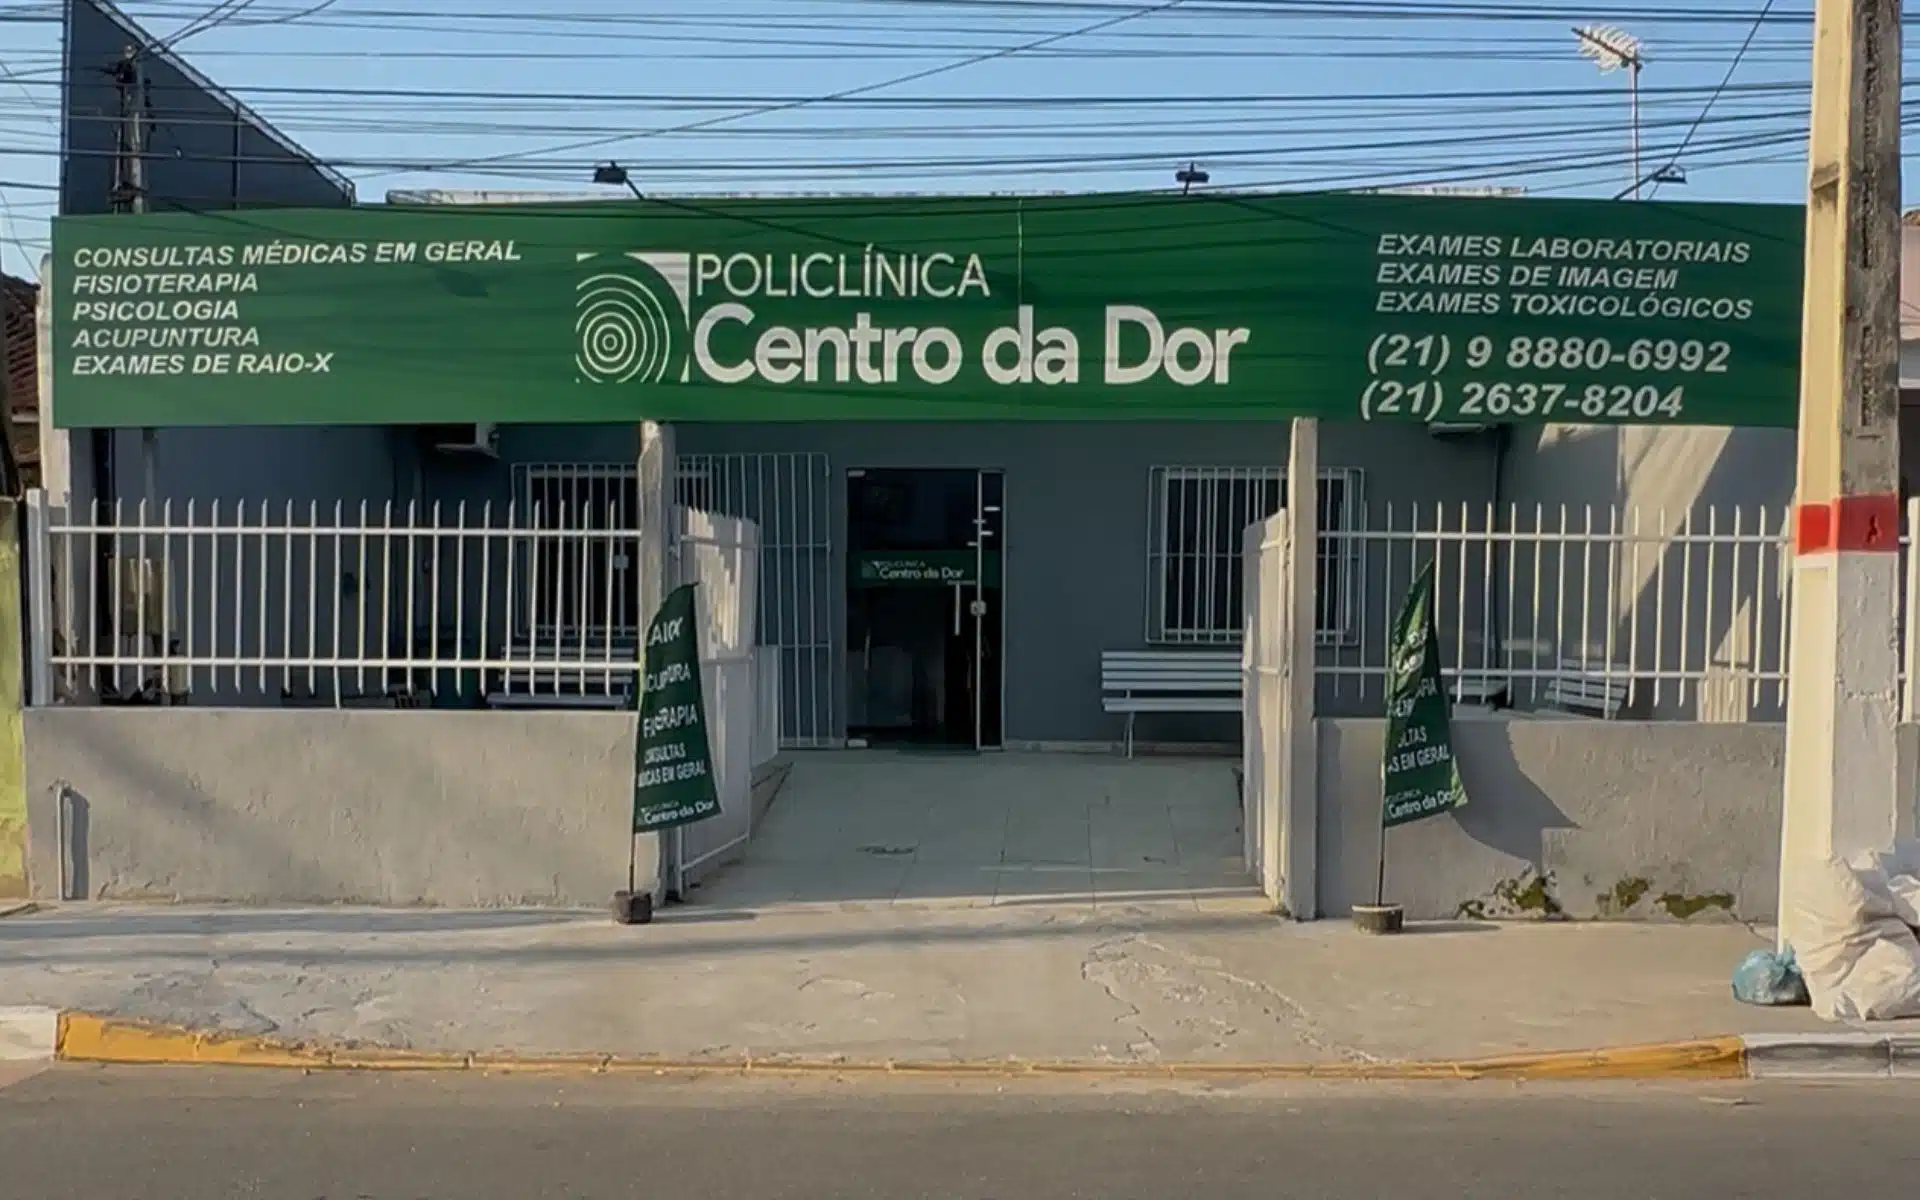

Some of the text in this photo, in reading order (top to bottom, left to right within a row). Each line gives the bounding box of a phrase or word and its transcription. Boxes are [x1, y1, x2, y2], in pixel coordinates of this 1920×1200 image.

[73, 240, 522, 268] CONSULTAS MÉDICAS EM GERAL
[1378, 233, 1751, 263] EXAMES LABORATORIAIS
[72, 272, 259, 295] FISIOTERAPIA
[696, 243, 991, 298] POLICLÍNICA
[1376, 262, 1679, 290] EXAMES DE IMAGEM
[72, 300, 240, 322] PSICOLOGIA
[1375, 291, 1753, 320] EXAMES TOXICOLÓGICOS
[71, 326, 260, 348] ACUPUNTURA
[694, 302, 1251, 386] Centro da Dor
[72, 352, 334, 376] EXAMES DE RAIO-X
[1367, 333, 1731, 375] (21) 9 8880-6992
[1360, 380, 1685, 422] (21) 2637-8204
[879, 566, 964, 579] Centro da Dor
[643, 799, 715, 825] Centro da Dor
[1388, 800, 1422, 819] Centro
[1422, 793, 1437, 810] da
[1437, 789, 1454, 805] Do
